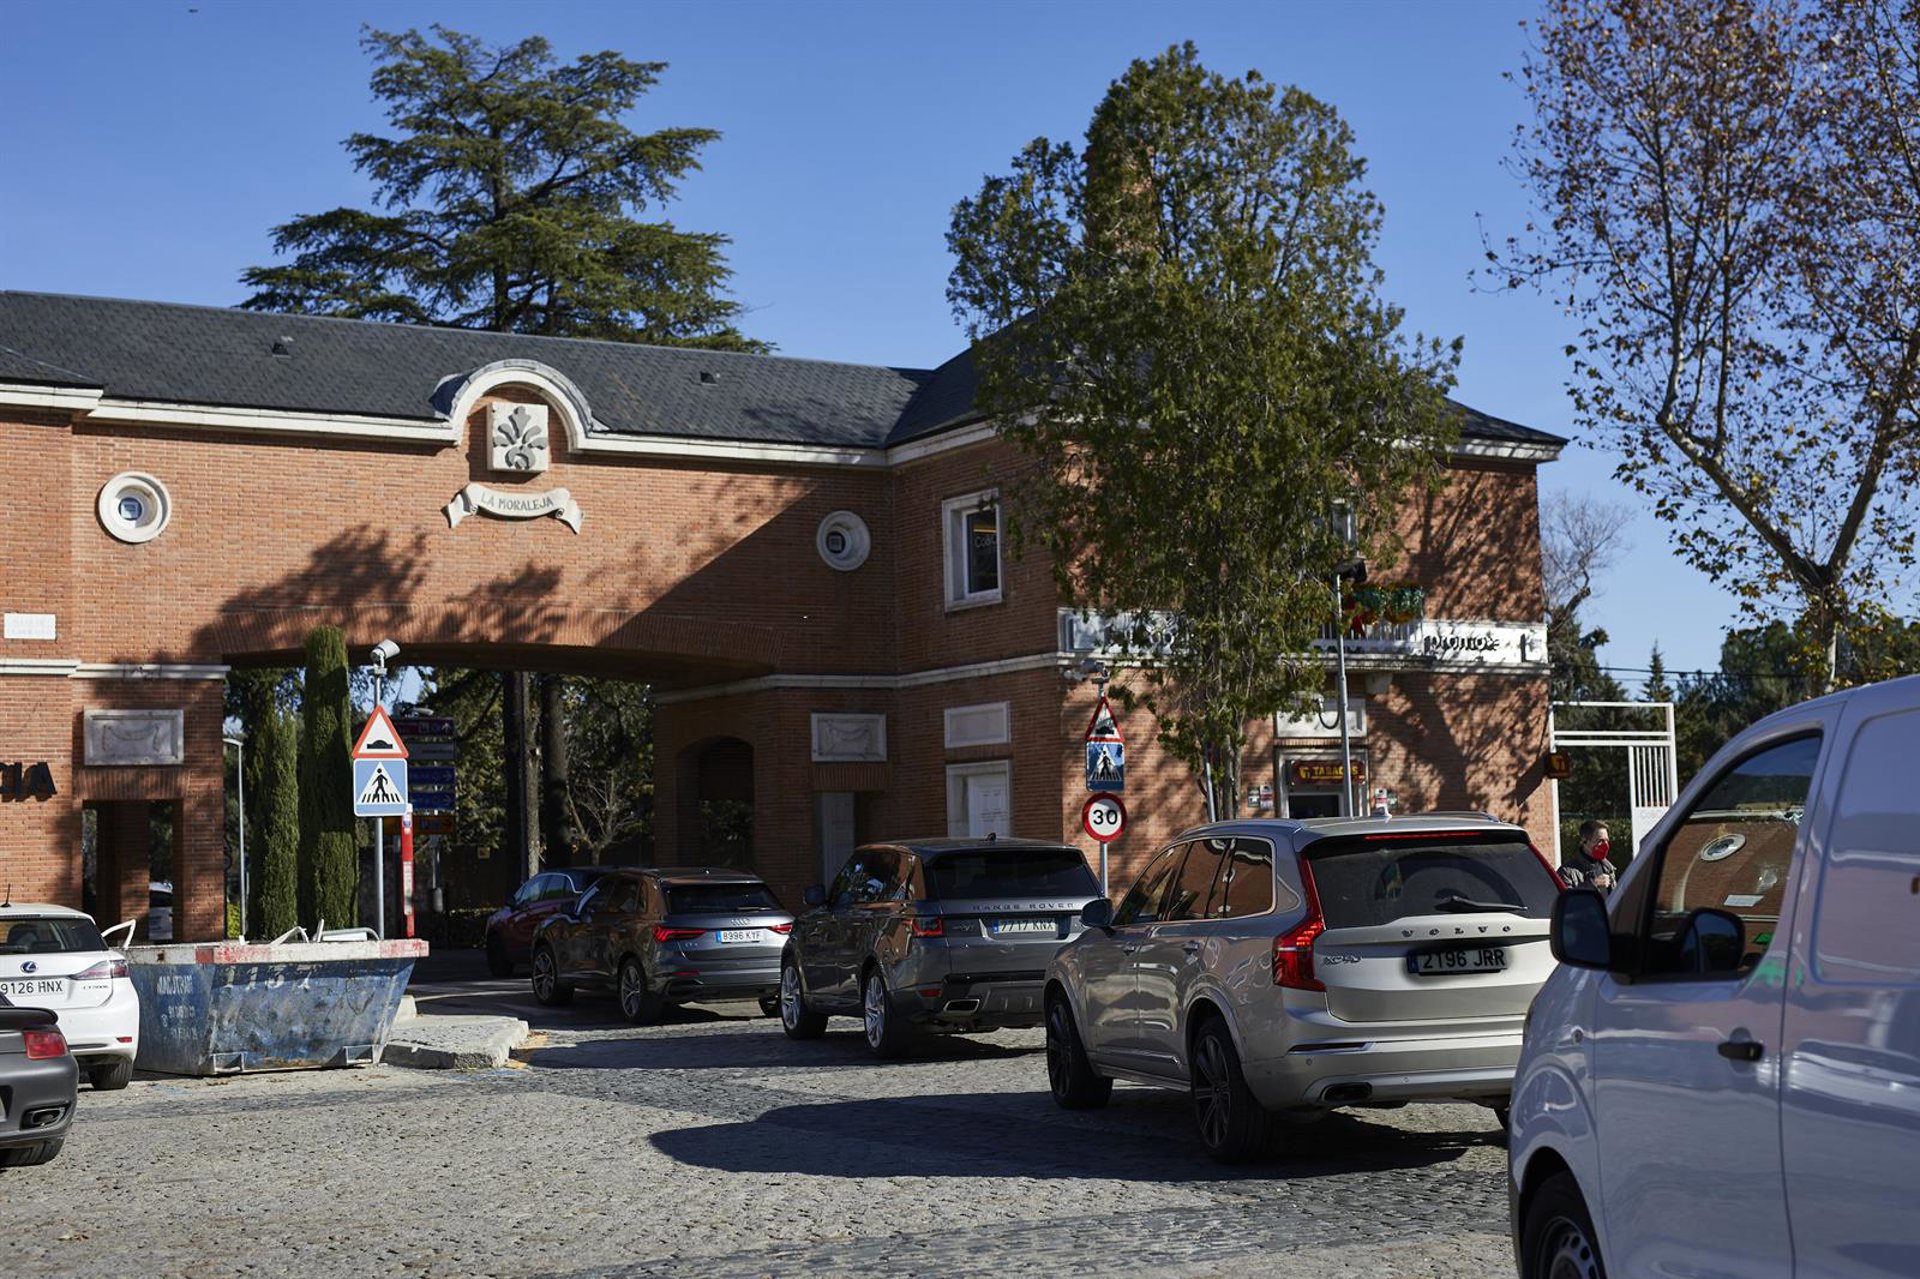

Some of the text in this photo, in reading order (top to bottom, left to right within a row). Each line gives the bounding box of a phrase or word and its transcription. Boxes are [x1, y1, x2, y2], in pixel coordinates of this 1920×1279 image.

[481, 492, 554, 511] LA MORALEJA
[1313, 766, 1359, 776] TABACS
[1093, 809, 1118, 825] 30
[1402, 926, 1512, 937] VOLVO
[1423, 948, 1506, 969] 2196 JRR
[0, 981, 63, 995] 9126 HNX
